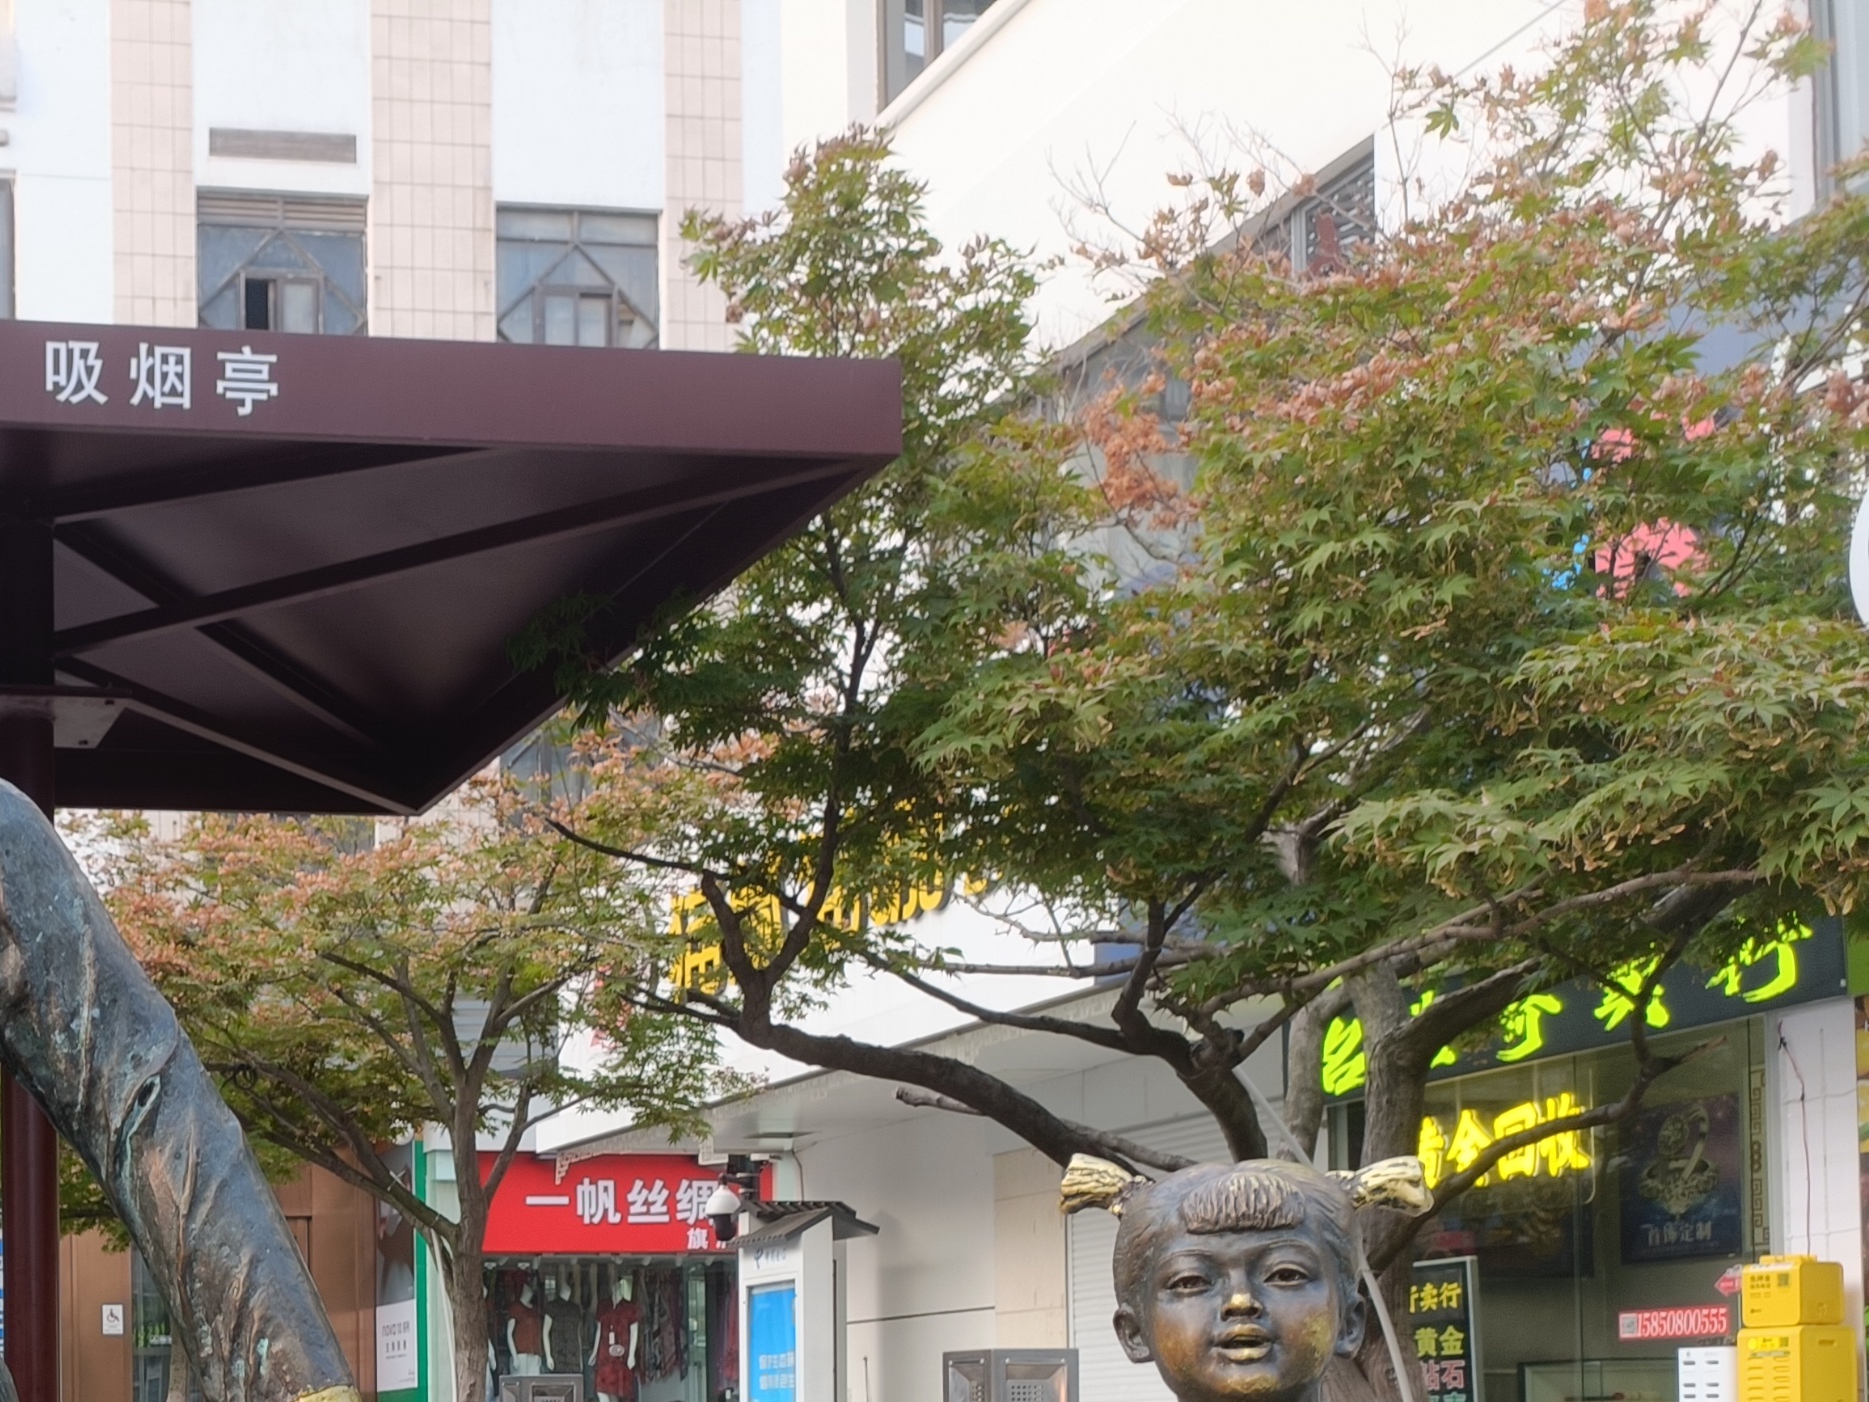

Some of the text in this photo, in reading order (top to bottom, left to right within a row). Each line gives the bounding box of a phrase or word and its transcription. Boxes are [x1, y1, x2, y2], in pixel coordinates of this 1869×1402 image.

[45, 340, 278, 416] 吸烟亭
[525, 1177, 719, 1226] 一帆丝绸
[1415, 1325, 1465, 1357] 黄金
[1637, 1307, 1727, 1337] 15850800555
